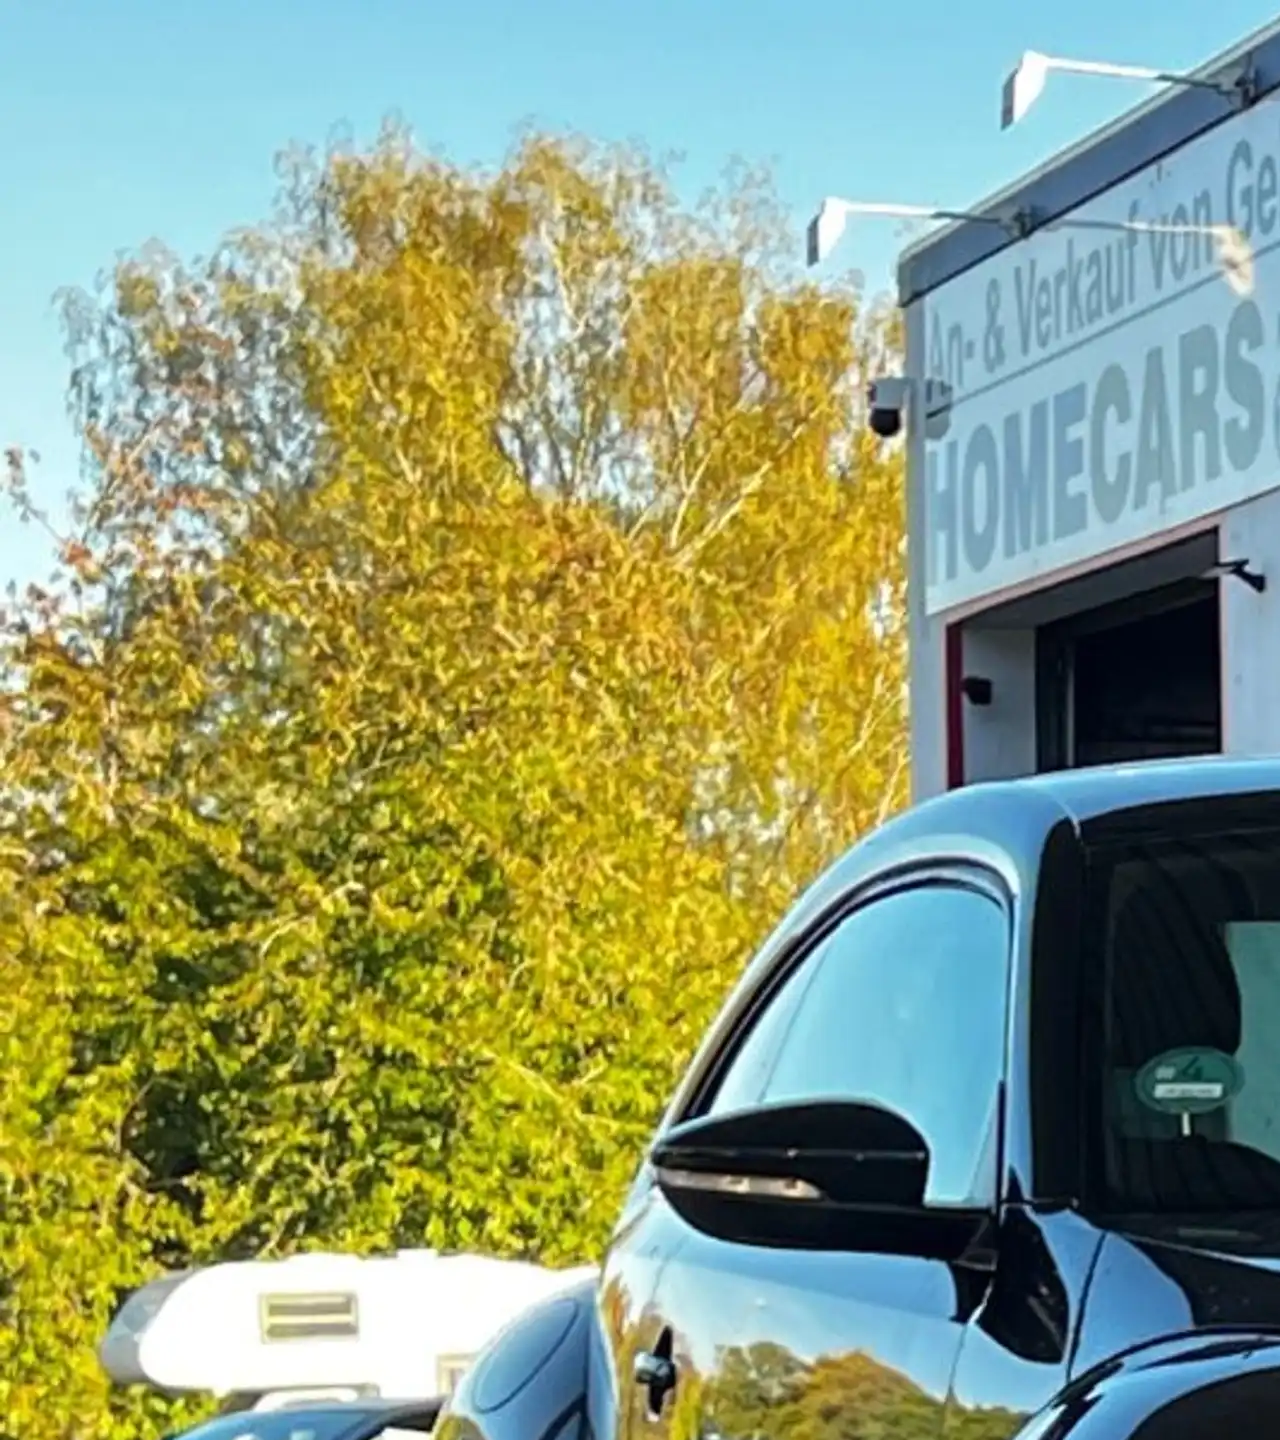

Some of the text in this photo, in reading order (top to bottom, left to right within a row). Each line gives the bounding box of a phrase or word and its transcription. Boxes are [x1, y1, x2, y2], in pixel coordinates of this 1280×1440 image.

[983, 277, 1006, 374] &
[1013, 199, 1140, 357] Verkauf
[1150, 188, 1215, 290] von
[926, 299, 1265, 588] HOMECARS
